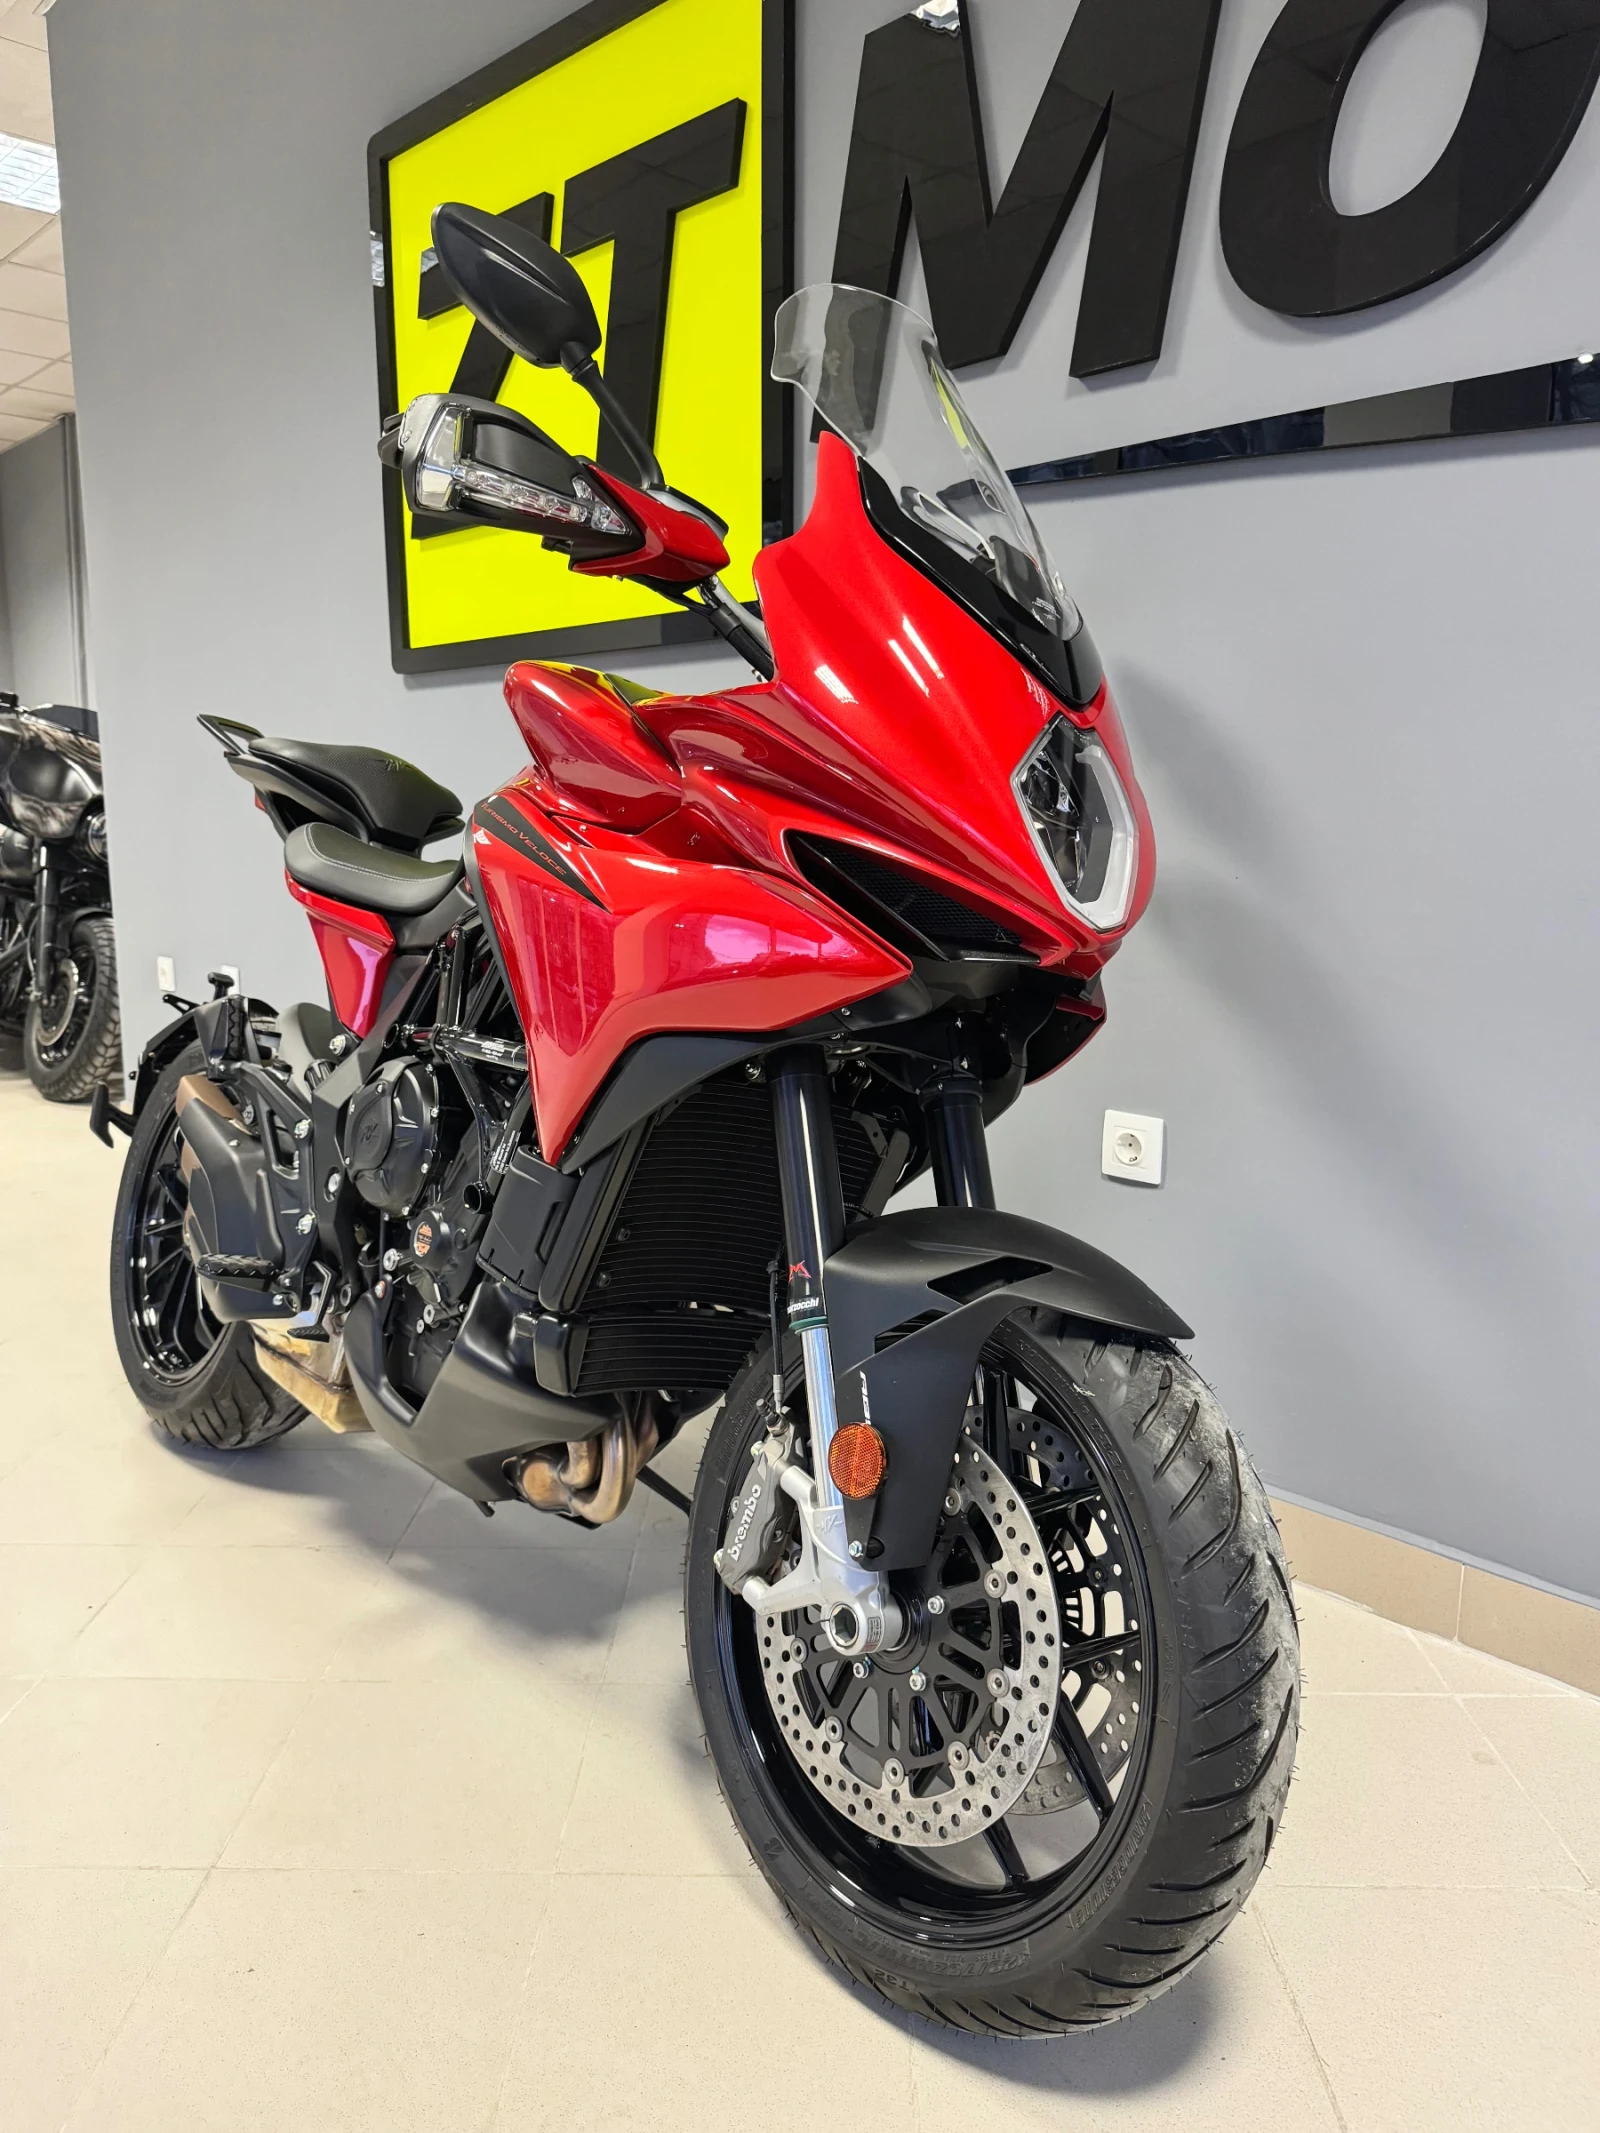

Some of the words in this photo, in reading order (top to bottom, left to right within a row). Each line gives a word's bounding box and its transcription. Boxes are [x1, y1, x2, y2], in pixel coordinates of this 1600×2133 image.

[519, 832, 567, 876] VELOCE
[860, 1370, 872, 1426] AB
[727, 1483, 762, 1562] brembo
